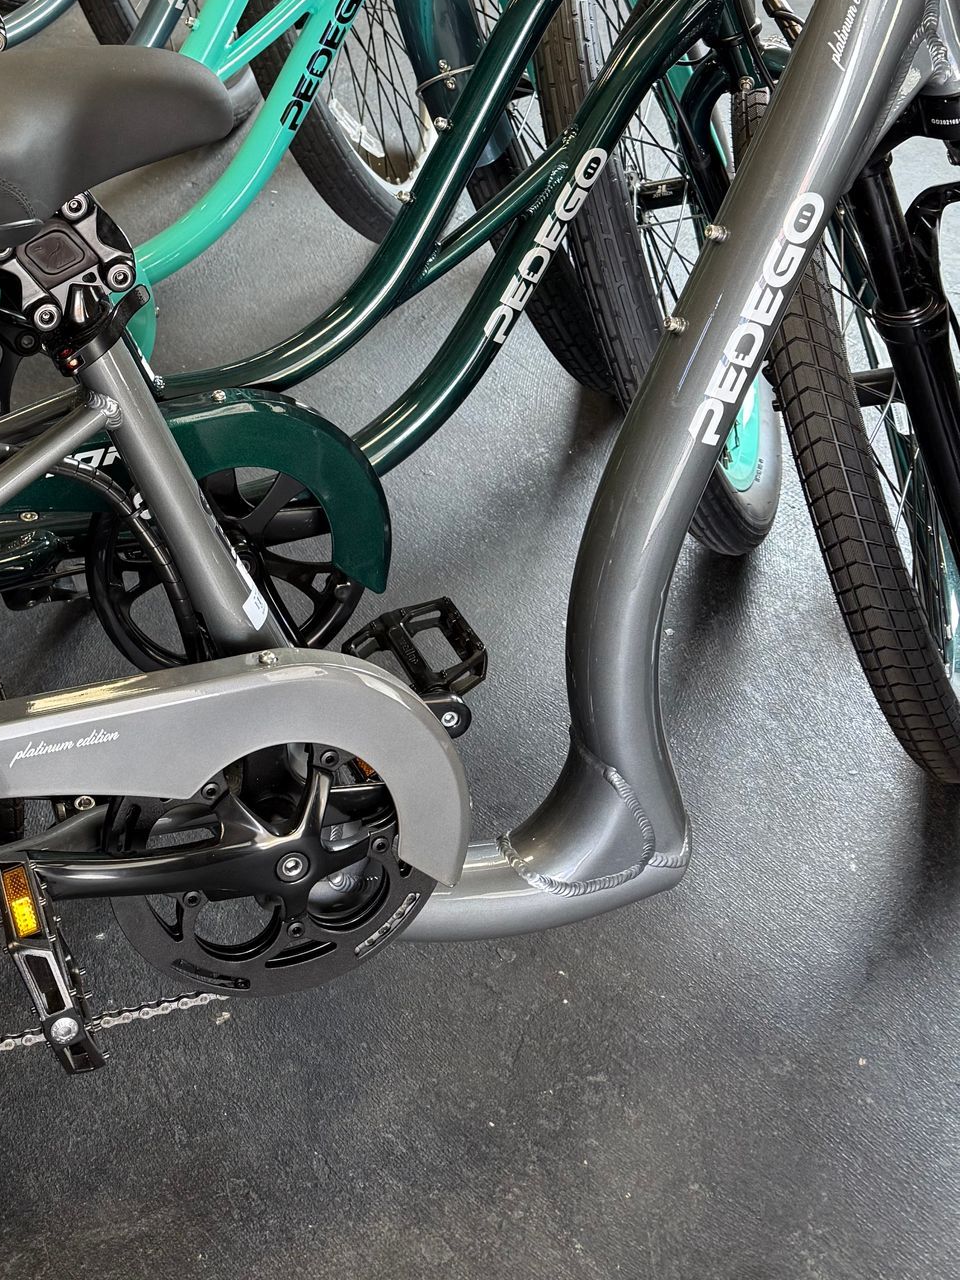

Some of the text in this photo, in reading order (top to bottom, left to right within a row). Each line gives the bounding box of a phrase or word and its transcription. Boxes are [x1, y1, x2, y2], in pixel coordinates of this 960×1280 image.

[828, 4, 858, 71] platinum
[484, 148, 607, 343] PEDEGO
[689, 192, 824, 446] PEDEGO
[9, 740, 74, 769] platinum
[76, 728, 121, 749] edition
